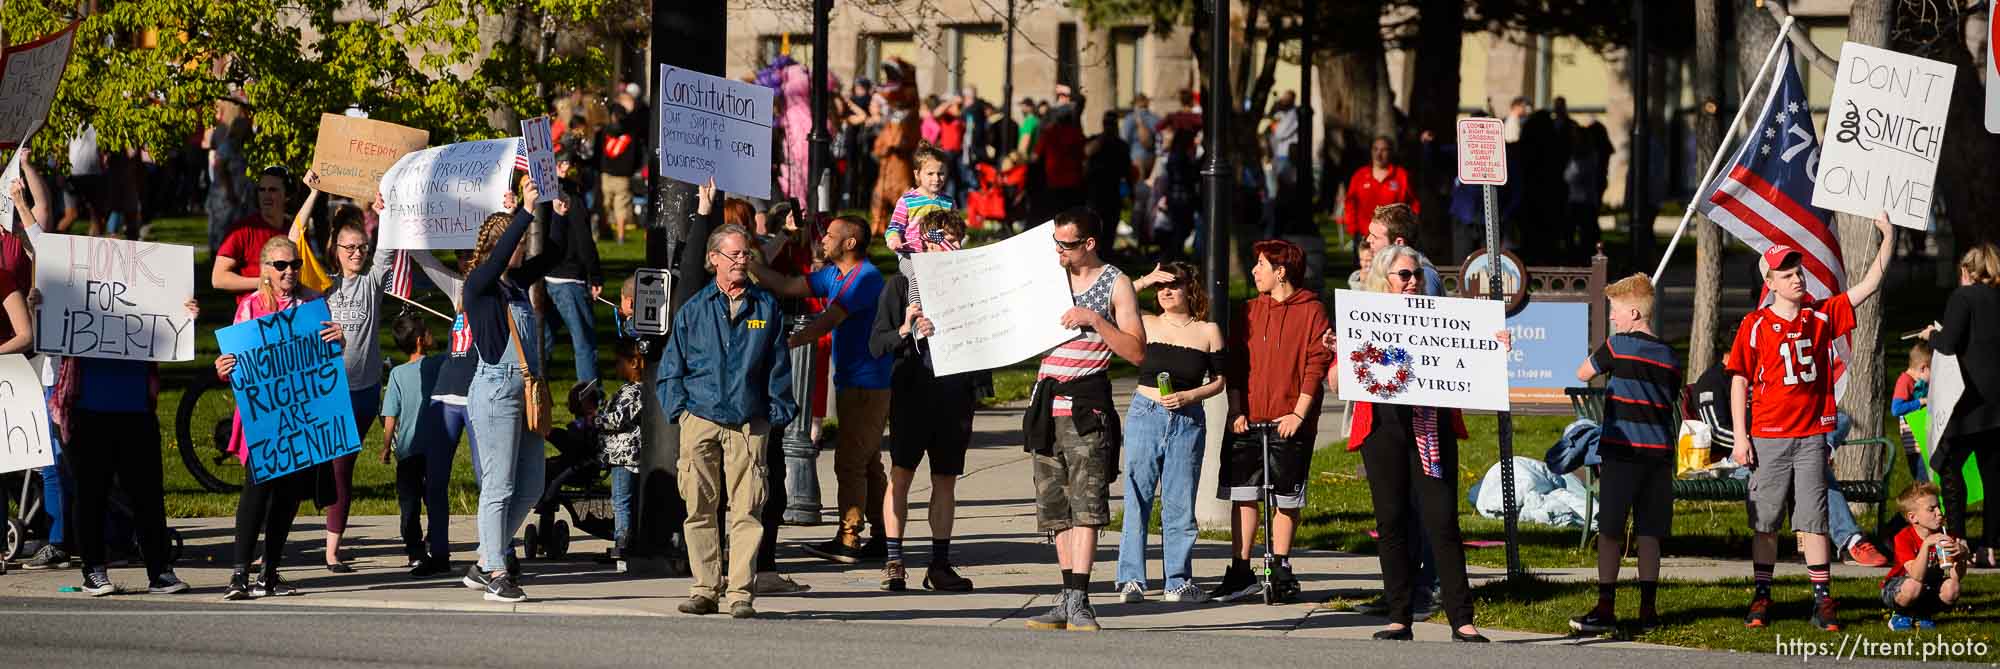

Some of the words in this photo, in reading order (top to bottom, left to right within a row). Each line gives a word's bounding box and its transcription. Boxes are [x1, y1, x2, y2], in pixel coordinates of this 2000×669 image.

[665, 68, 755, 120] Constitution
[1849, 56, 1944, 104] DON'T
[1864, 108, 1942, 158] SNITCH
[350, 139, 397, 158] FREEDOM
[665, 148, 716, 174] businesses
[731, 140, 755, 160] open
[457, 177, 482, 193] FOR
[1824, 166, 1870, 201] ON
[1883, 175, 1930, 219] ME
[390, 200, 447, 218] FAMILIES
[68, 236, 166, 288] HONK
[85, 280, 137, 312] FOR
[1405, 297, 1436, 310] THE
[258, 307, 298, 346] MY
[1349, 310, 1471, 332] CONSTITUTION
[1348, 327, 1362, 340] IS
[1371, 330, 1403, 344] NOT
[1408, 334, 1499, 351] CANCELLED
[1421, 355, 1440, 367] BY
[1456, 358, 1465, 369] A
[1779, 338, 1818, 386] 15
[245, 361, 338, 421] RIGHTS
[1417, 377, 1471, 393] VIRUS!
[278, 399, 319, 434] ARE
